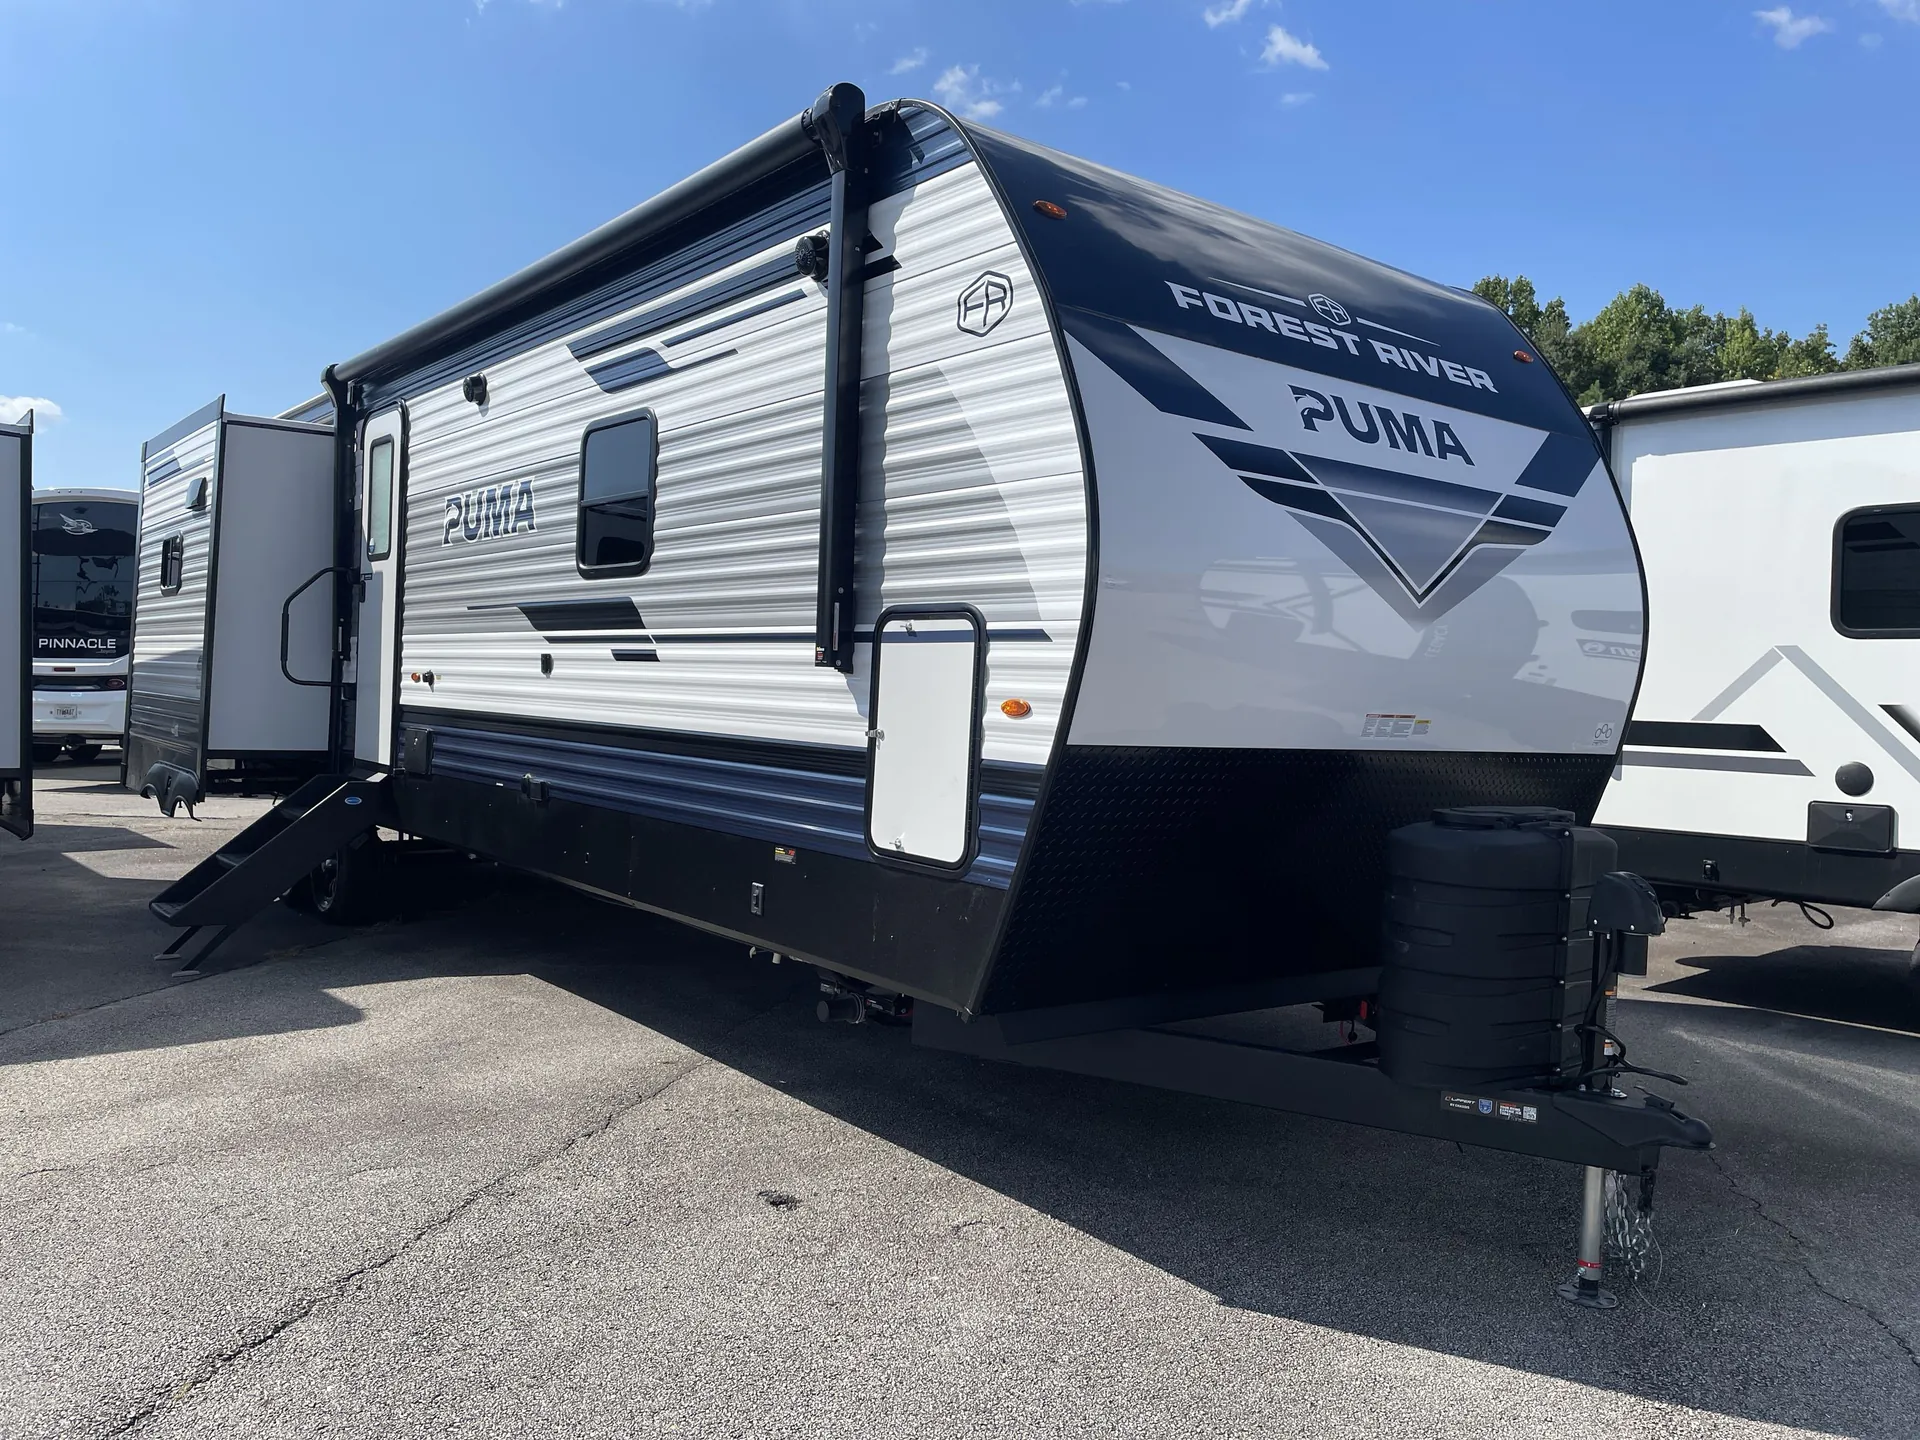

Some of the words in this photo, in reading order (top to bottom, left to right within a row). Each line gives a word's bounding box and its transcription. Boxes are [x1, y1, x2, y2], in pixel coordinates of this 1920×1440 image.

[1164, 280, 1360, 356] FOREST
[1367, 338, 1499, 394] RIVER
[1286, 383, 1476, 467] PUMA
[441, 476, 537, 547] PUMA
[38, 638, 117, 649] PINNACLE
